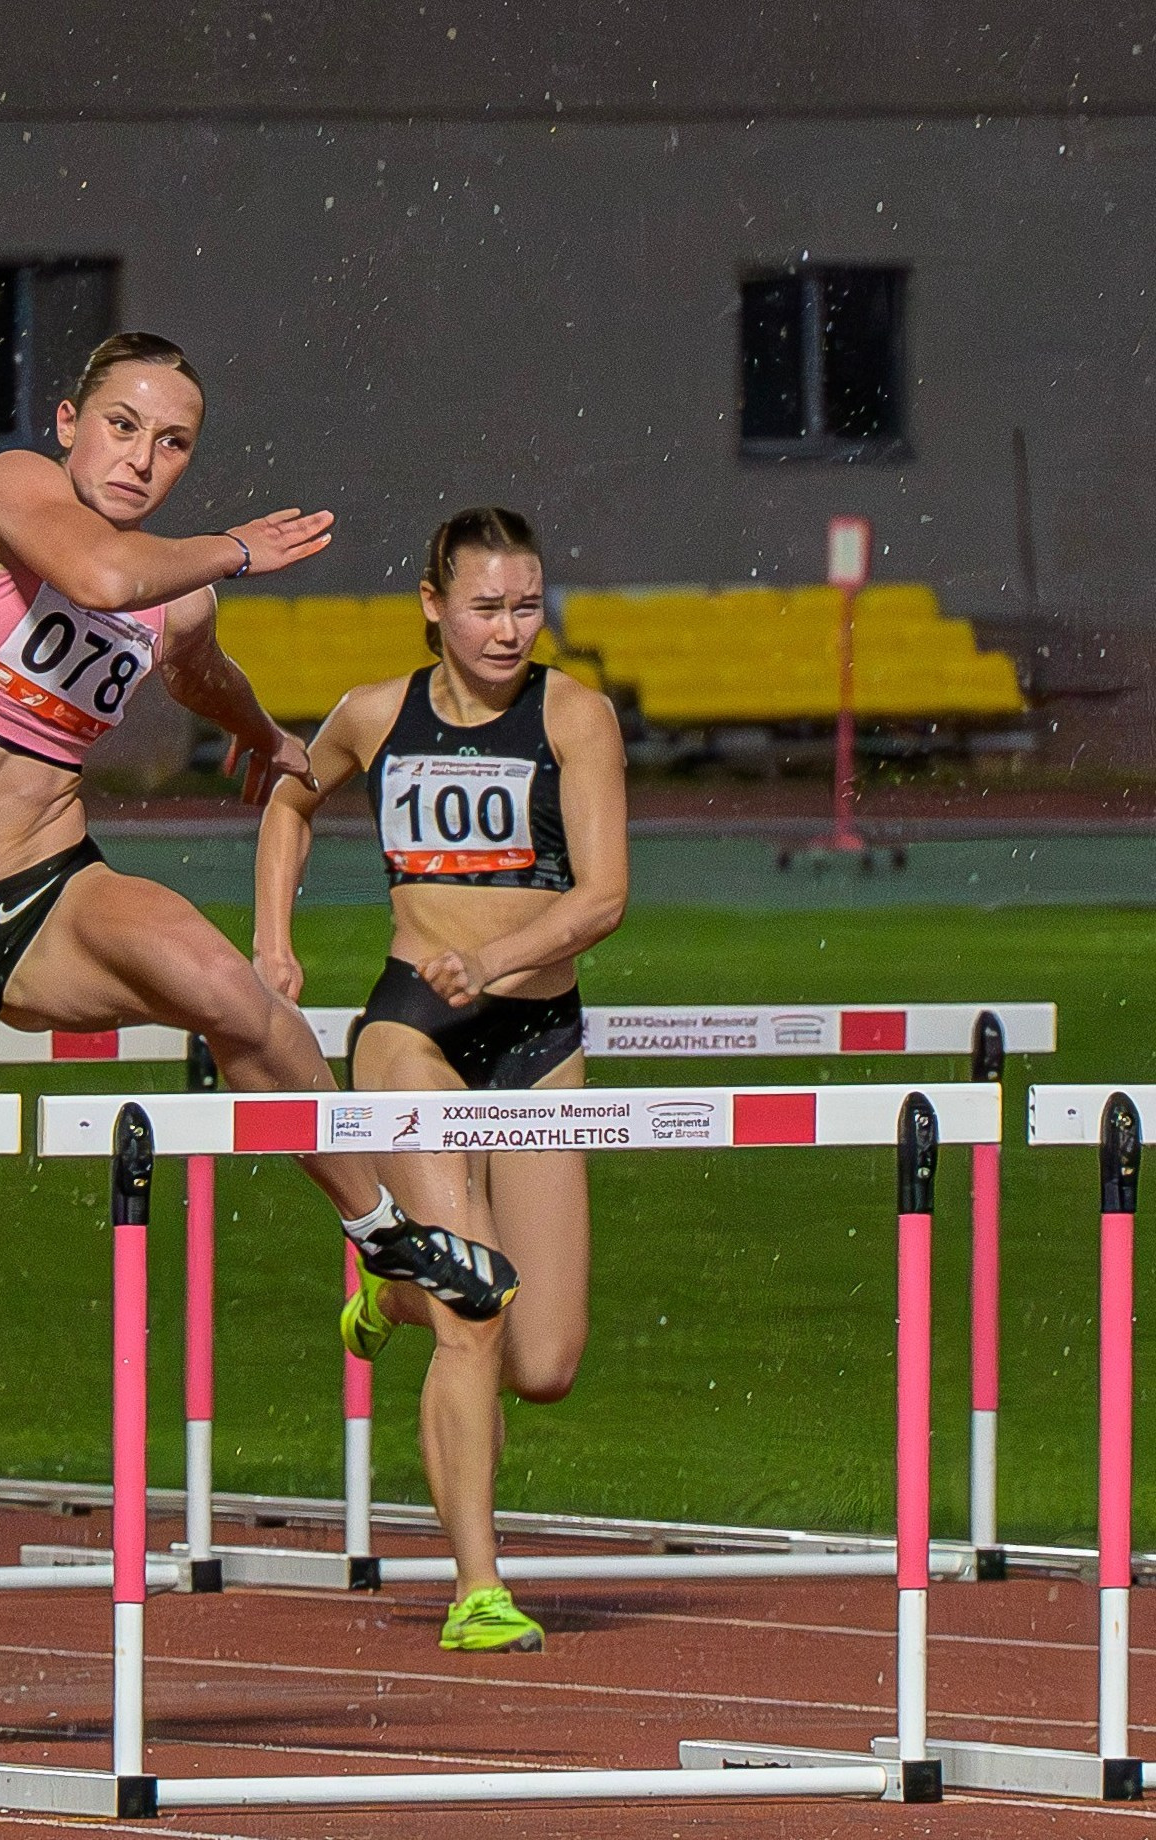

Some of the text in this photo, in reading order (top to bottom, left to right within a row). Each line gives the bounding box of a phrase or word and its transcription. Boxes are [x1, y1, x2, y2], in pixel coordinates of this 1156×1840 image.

[21, 611, 139, 714] 078
[395, 784, 515, 843] 100
[560, 1104, 630, 1119] Memorial
[651, 1117, 710, 1128] Continental
[442, 1127, 630, 1148] #QAZAQATHLETICS
[652, 1128, 673, 1139] Tour
